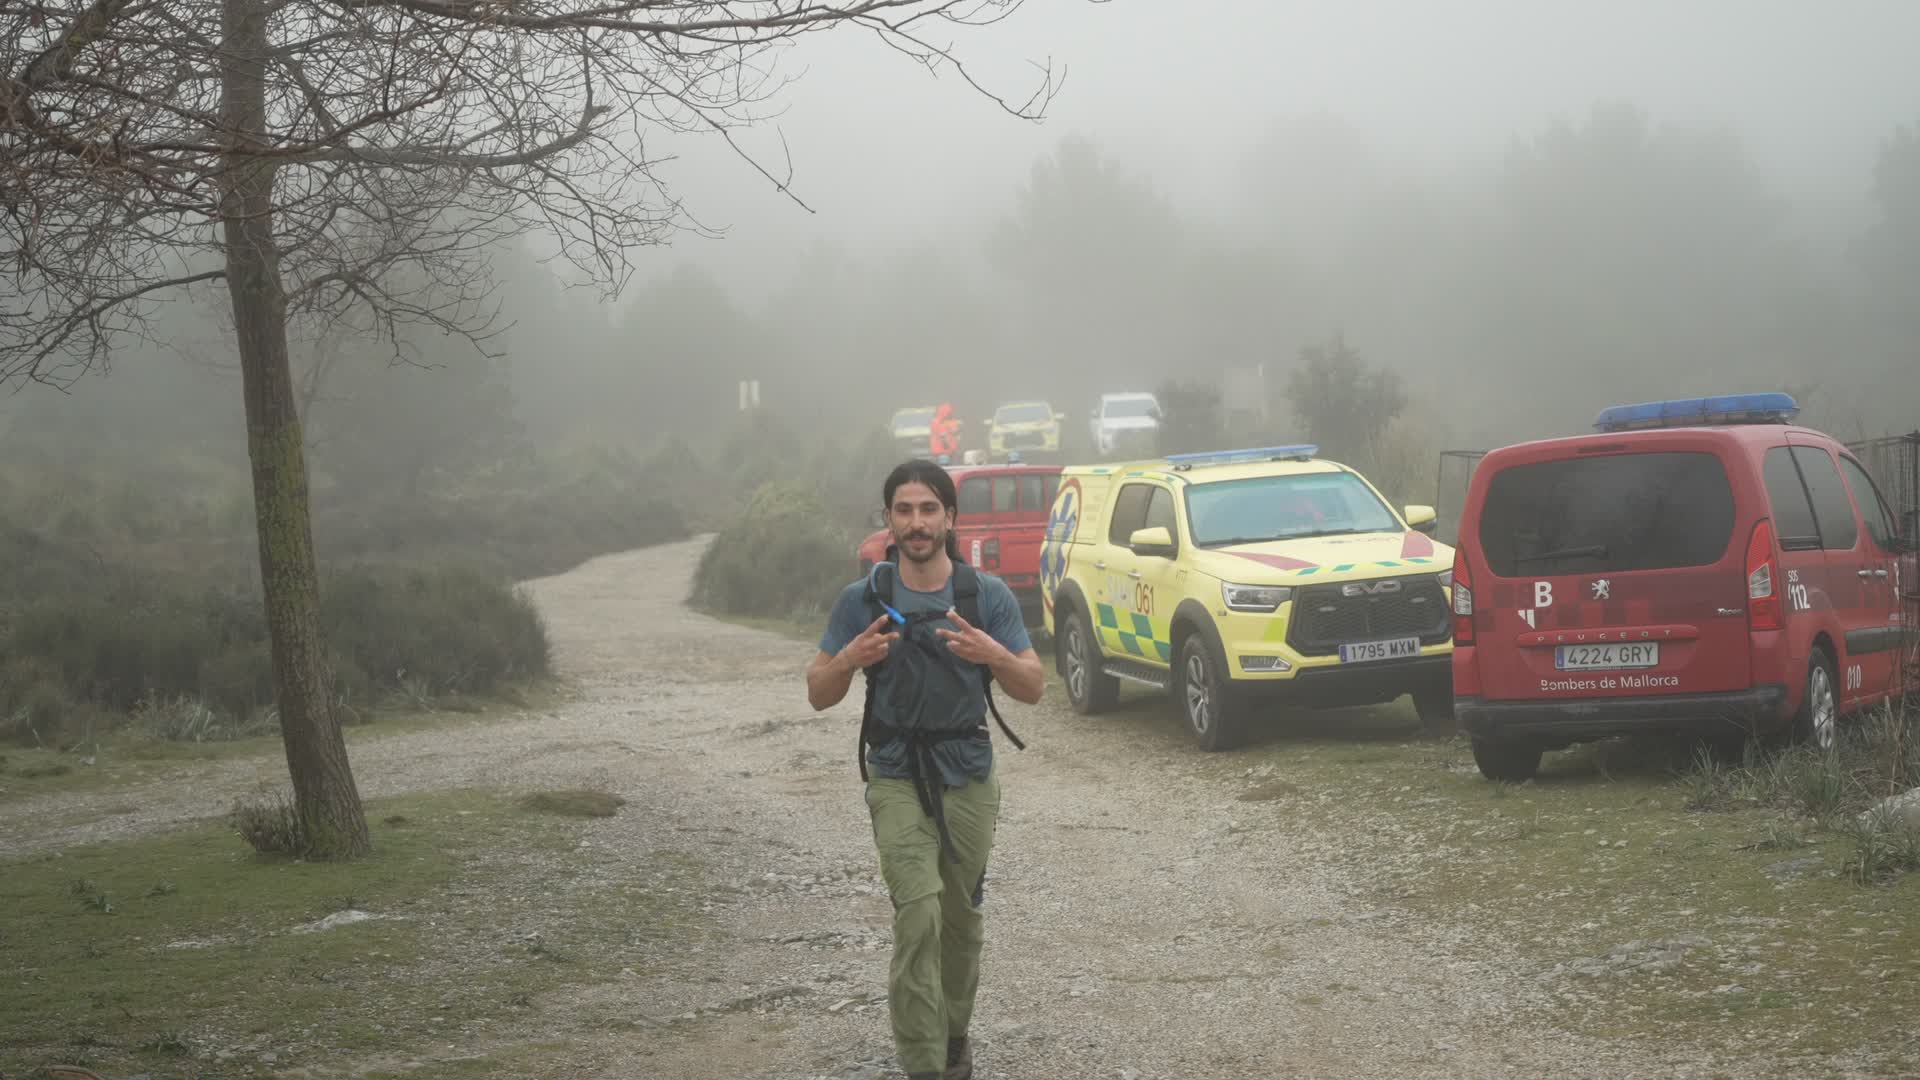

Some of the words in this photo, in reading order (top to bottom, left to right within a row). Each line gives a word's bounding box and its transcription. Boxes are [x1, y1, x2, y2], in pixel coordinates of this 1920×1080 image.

[1788, 570, 1799, 582] SOS
[1135, 582, 1155, 616] 061
[1535, 581, 1553, 607] B
[1790, 584, 1811, 610] 112
[1537, 629, 1671, 641] PEUGEOT
[1351, 645, 1385, 660] 1795
[1390, 640, 1416, 656] MXM
[1568, 647, 1612, 665] 4224
[1619, 646, 1654, 663] GRY
[1540, 678, 1597, 691] Bombers
[1600, 676, 1617, 689] de
[1620, 674, 1679, 689] Mallorca
[1847, 664, 1862, 691] 010
